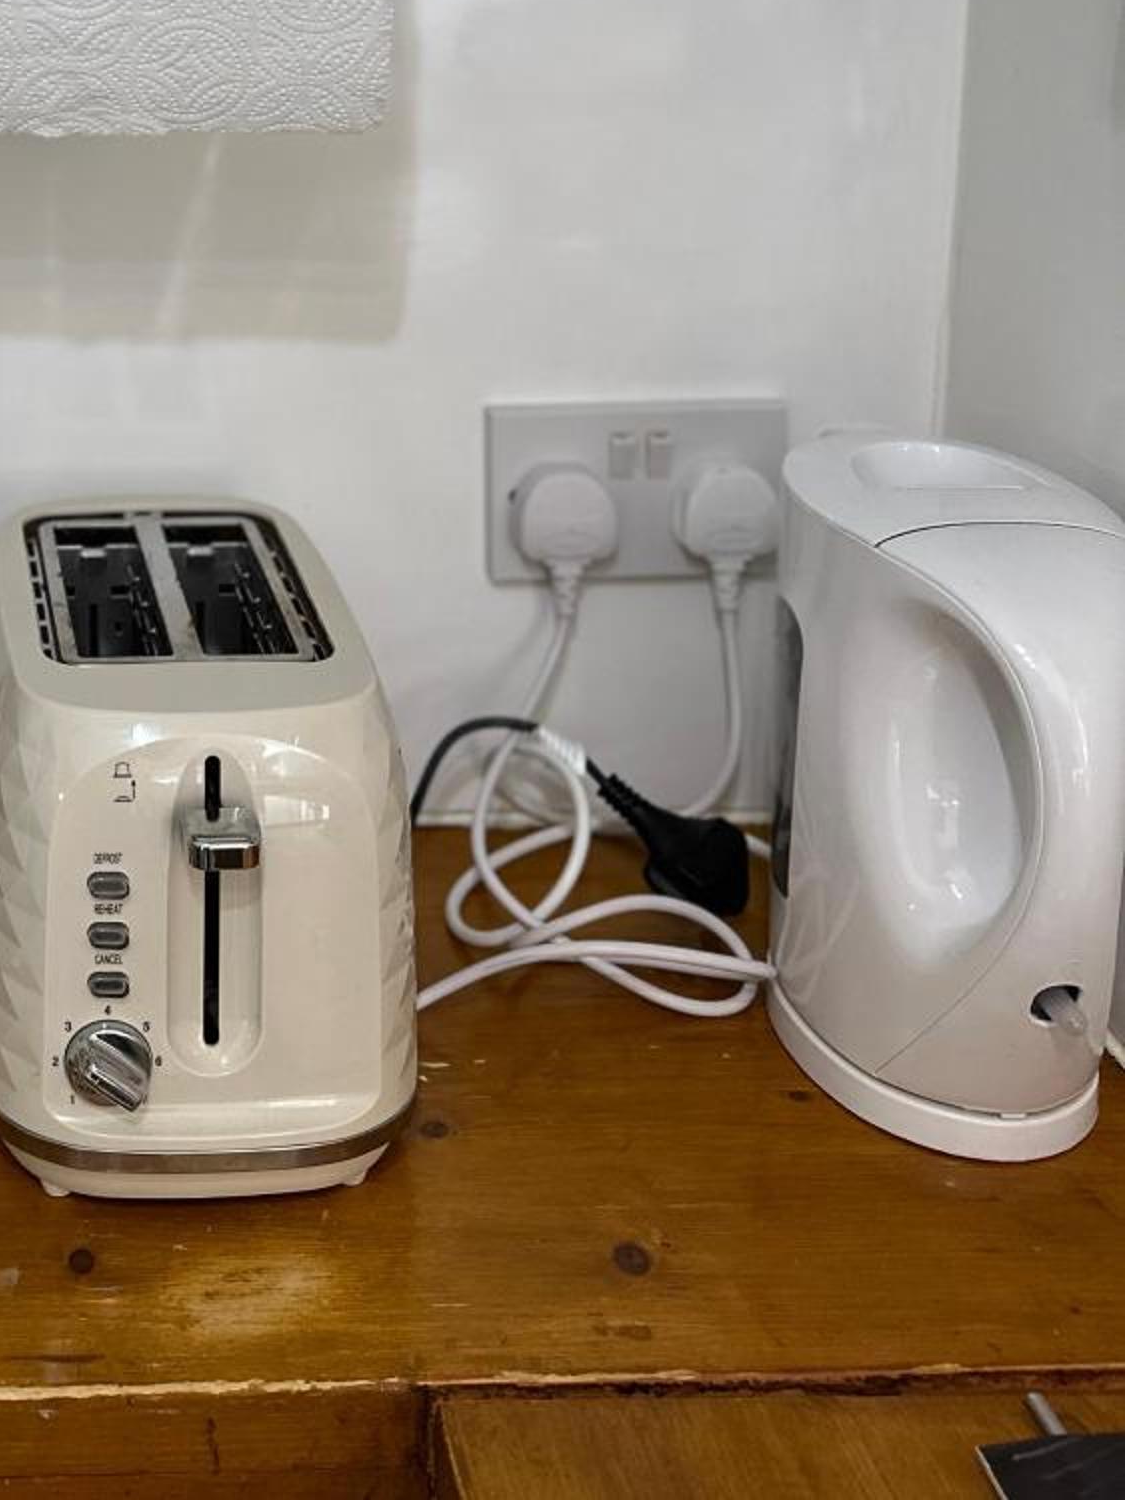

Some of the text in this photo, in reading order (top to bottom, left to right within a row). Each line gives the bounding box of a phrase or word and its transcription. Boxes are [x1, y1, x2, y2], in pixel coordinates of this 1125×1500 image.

[93, 903, 123, 916] REHEAT
[94, 953, 123, 965] CANCEL
[104, 1005, 111, 1015] 4
[64, 1021, 72, 1032] 3
[143, 1021, 150, 1032] 5
[52, 1056, 60, 1067] 2
[155, 1056, 162, 1067] 6
